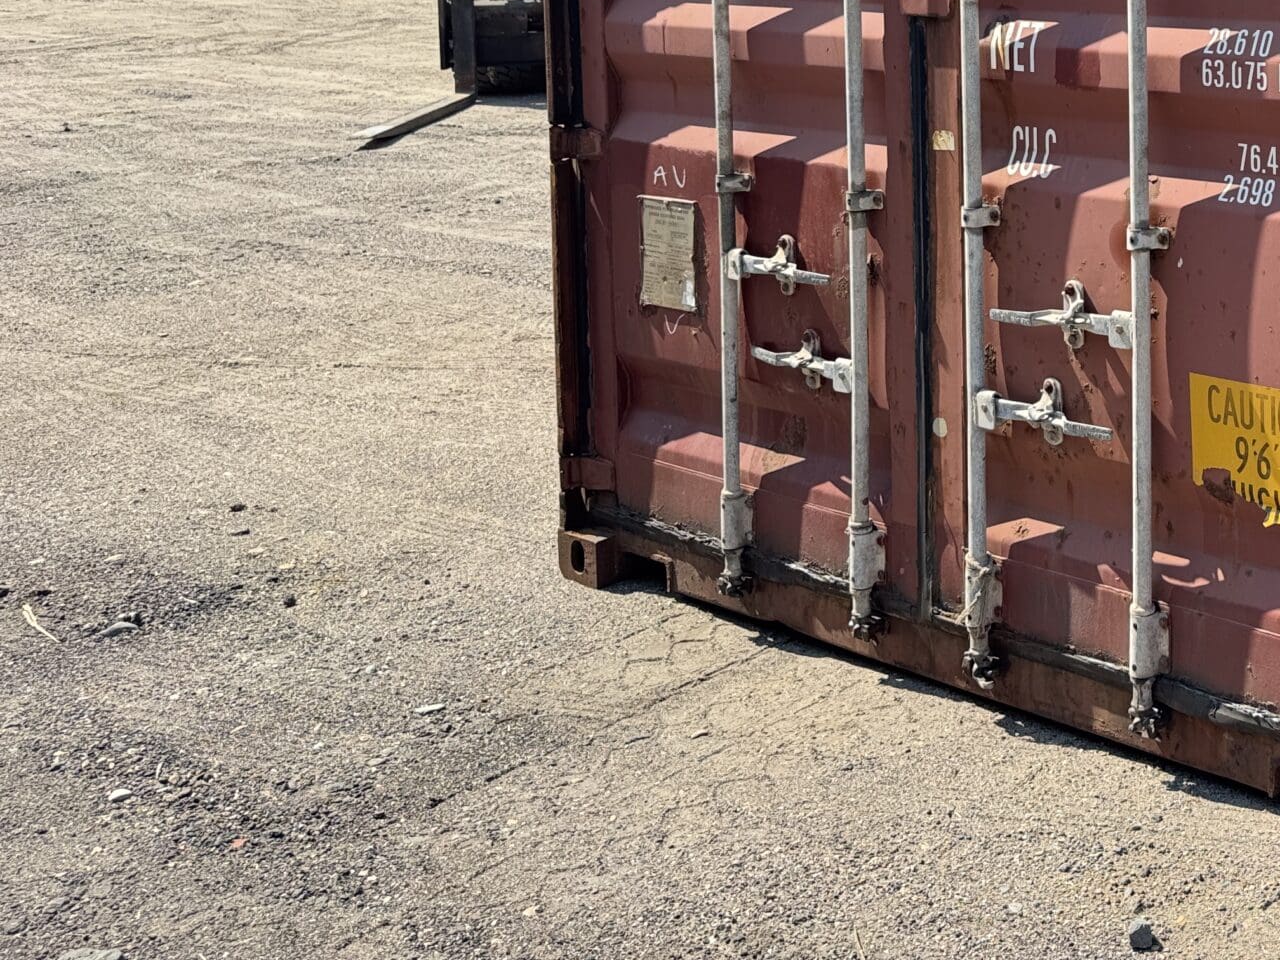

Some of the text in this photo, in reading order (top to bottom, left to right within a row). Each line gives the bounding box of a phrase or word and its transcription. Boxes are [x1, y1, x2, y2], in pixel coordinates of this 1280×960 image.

[990, 20, 1046, 73] NET
[1203, 27, 1274, 57] 28,610
[1201, 59, 1268, 92] 63,075
[1237, 143, 1279, 176] 76.4
[1218, 174, 1276, 207] 2,698
